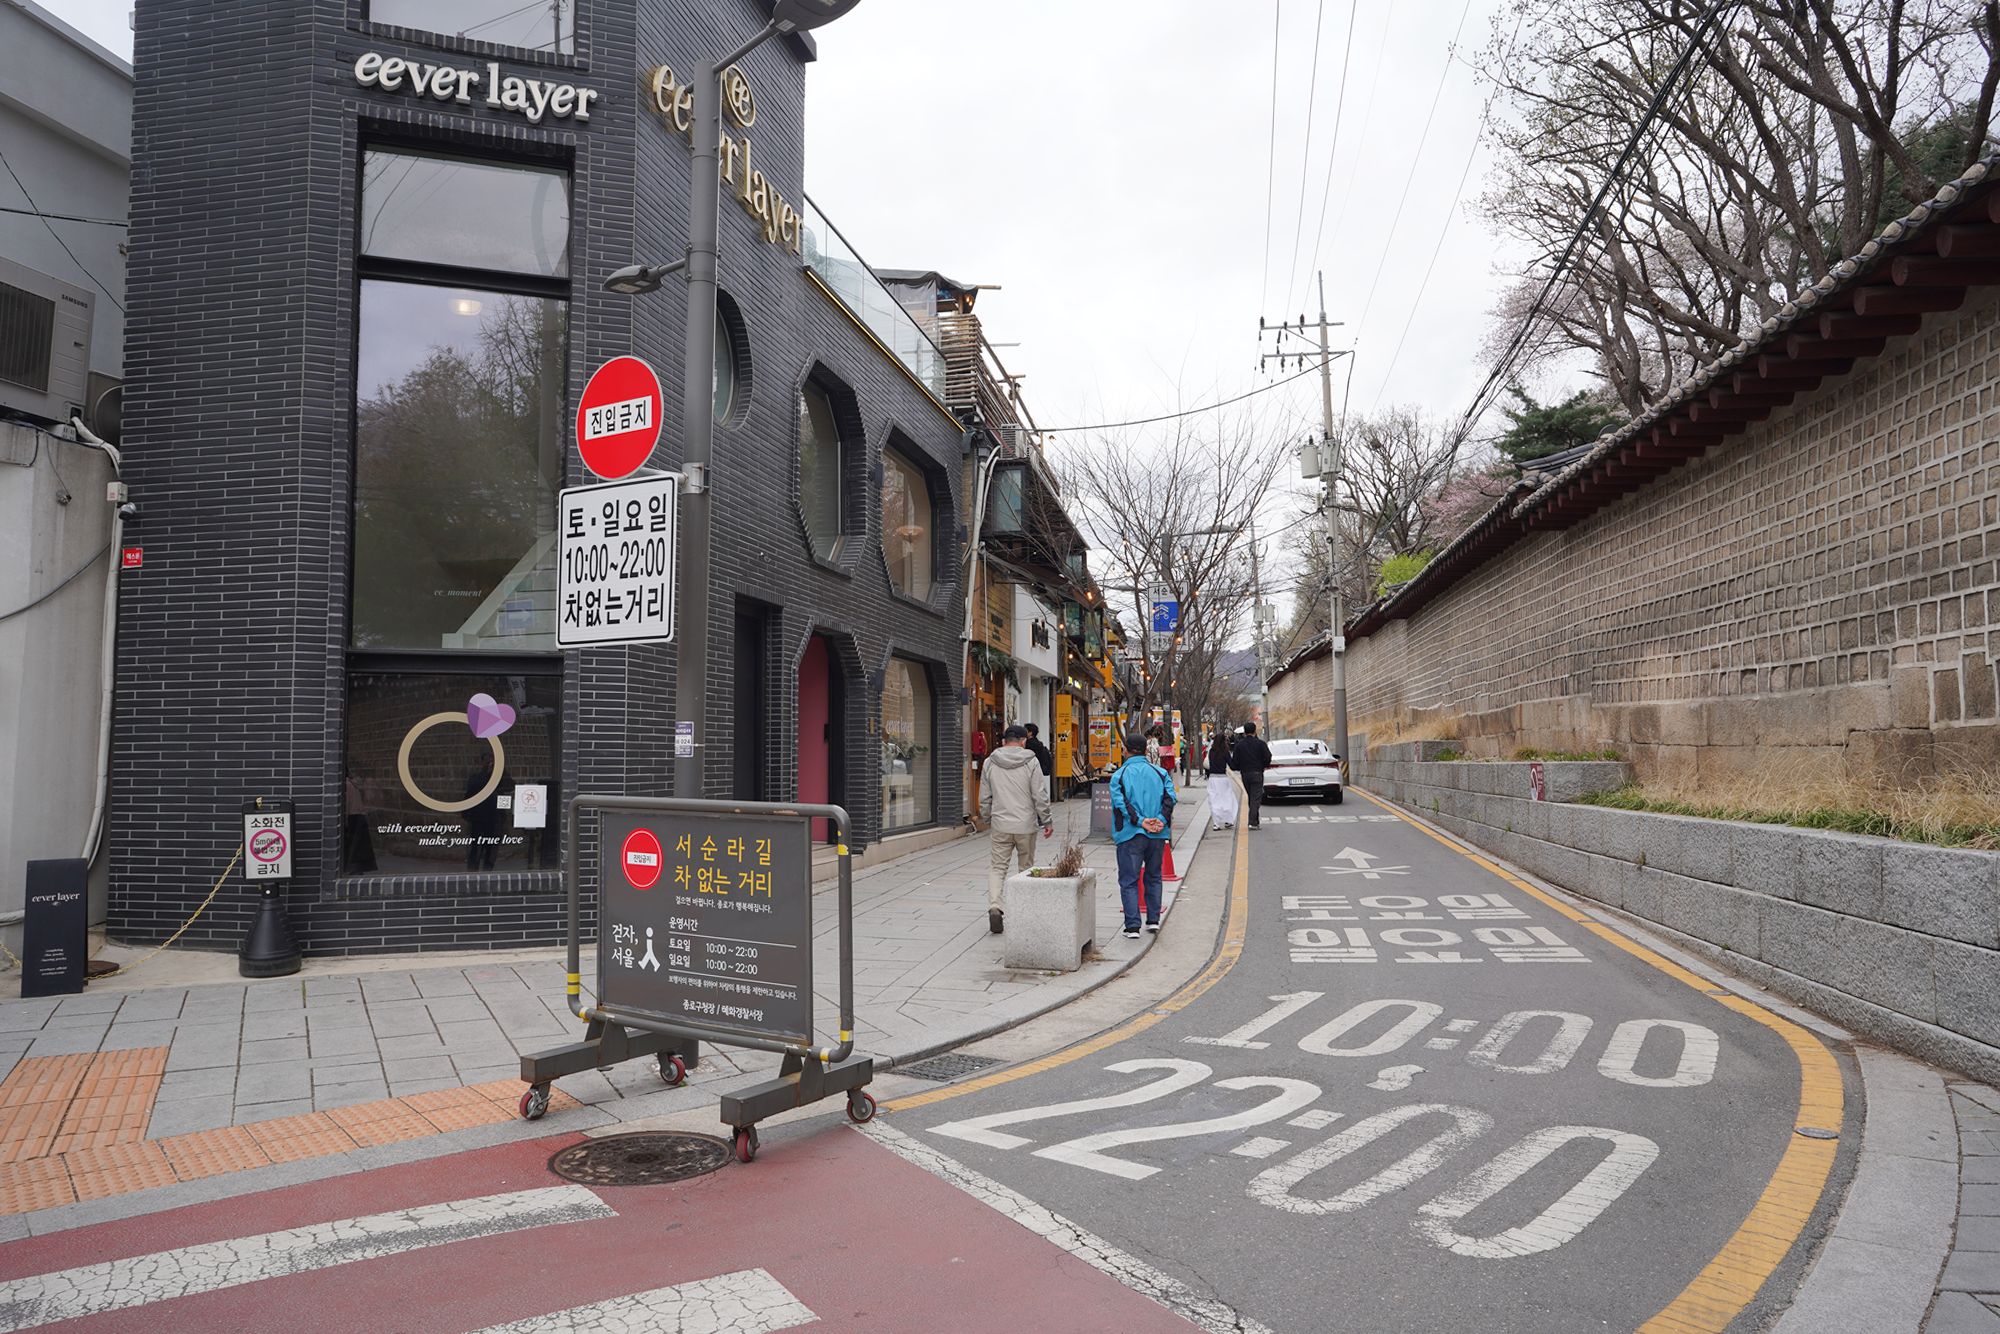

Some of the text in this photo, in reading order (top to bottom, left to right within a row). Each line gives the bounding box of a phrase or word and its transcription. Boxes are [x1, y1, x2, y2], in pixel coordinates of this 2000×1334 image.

[355, 53, 598, 124] eever layer
[61, 294, 88, 309] SAMSUNG
[591, 400, 647, 435] 진입금지
[566, 537, 665, 584] 10:00~22:00
[564, 583, 664, 628] 차없는거리
[251, 817, 285, 828] 소화전
[377, 822, 462, 835] with eeverlayer,
[418, 834, 524, 848] make your true love
[257, 864, 280, 875] 금지
[633, 854, 652, 864] 진입금지
[674, 865, 772, 898] 차 없는 거리
[57, 892, 81, 903] layer
[1280, 893, 1533, 921] 토요일
[612, 923, 639, 945] 걷자,
[669, 916, 699, 931] 운영시간
[669, 938, 691, 952] 토요일
[705, 943, 727, 955] 10:00
[735, 946, 758, 958] 22:00
[1286, 926, 1593, 963] 일요일
[612, 947, 635, 969] 서울
[669, 953, 691, 968] 일요일
[705, 959, 727, 971] 10:00
[735, 962, 758, 975] 22:00
[683, 999, 715, 1014] 종로구청장
[721, 1005, 763, 1022] 혜화경찰서장
[1180, 990, 1720, 1088] 10:00
[924, 1057, 1661, 1260] 22:00
